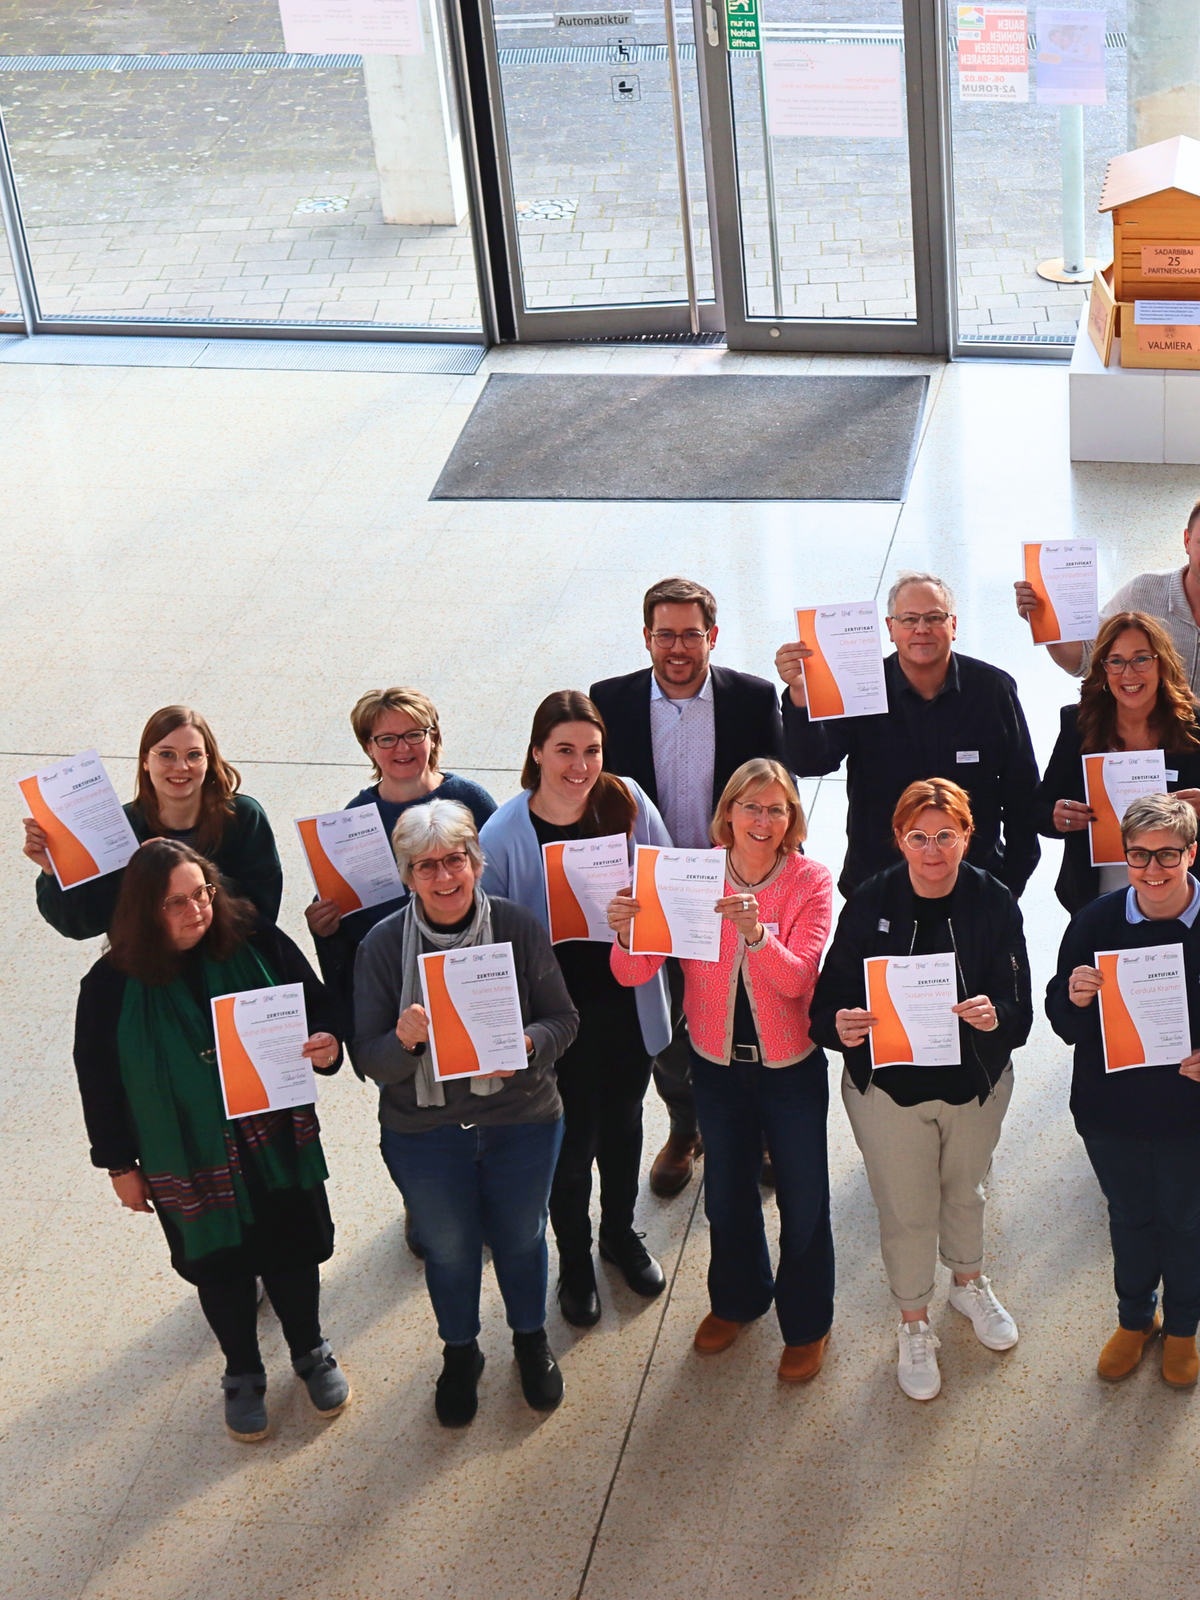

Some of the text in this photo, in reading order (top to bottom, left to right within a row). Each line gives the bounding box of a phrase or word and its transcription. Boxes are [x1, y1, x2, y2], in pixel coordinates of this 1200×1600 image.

[558, 15, 629, 26] Automatiktür
[745, 19, 755, 27] im
[731, 29, 756, 37] Notfall
[732, 39, 756, 47] öffnen
[1168, 257, 1180, 266] 25
[1148, 341, 1192, 350] VALMIERA
[72, 775, 102, 790] ZERTIFIKAT
[348, 826, 377, 838] ZERTIFIKAT
[477, 971, 509, 979] ZERTIFIKAT
[1131, 987, 1156, 995] Cordula
[267, 1010, 298, 1018] ZERTIFIKAT
